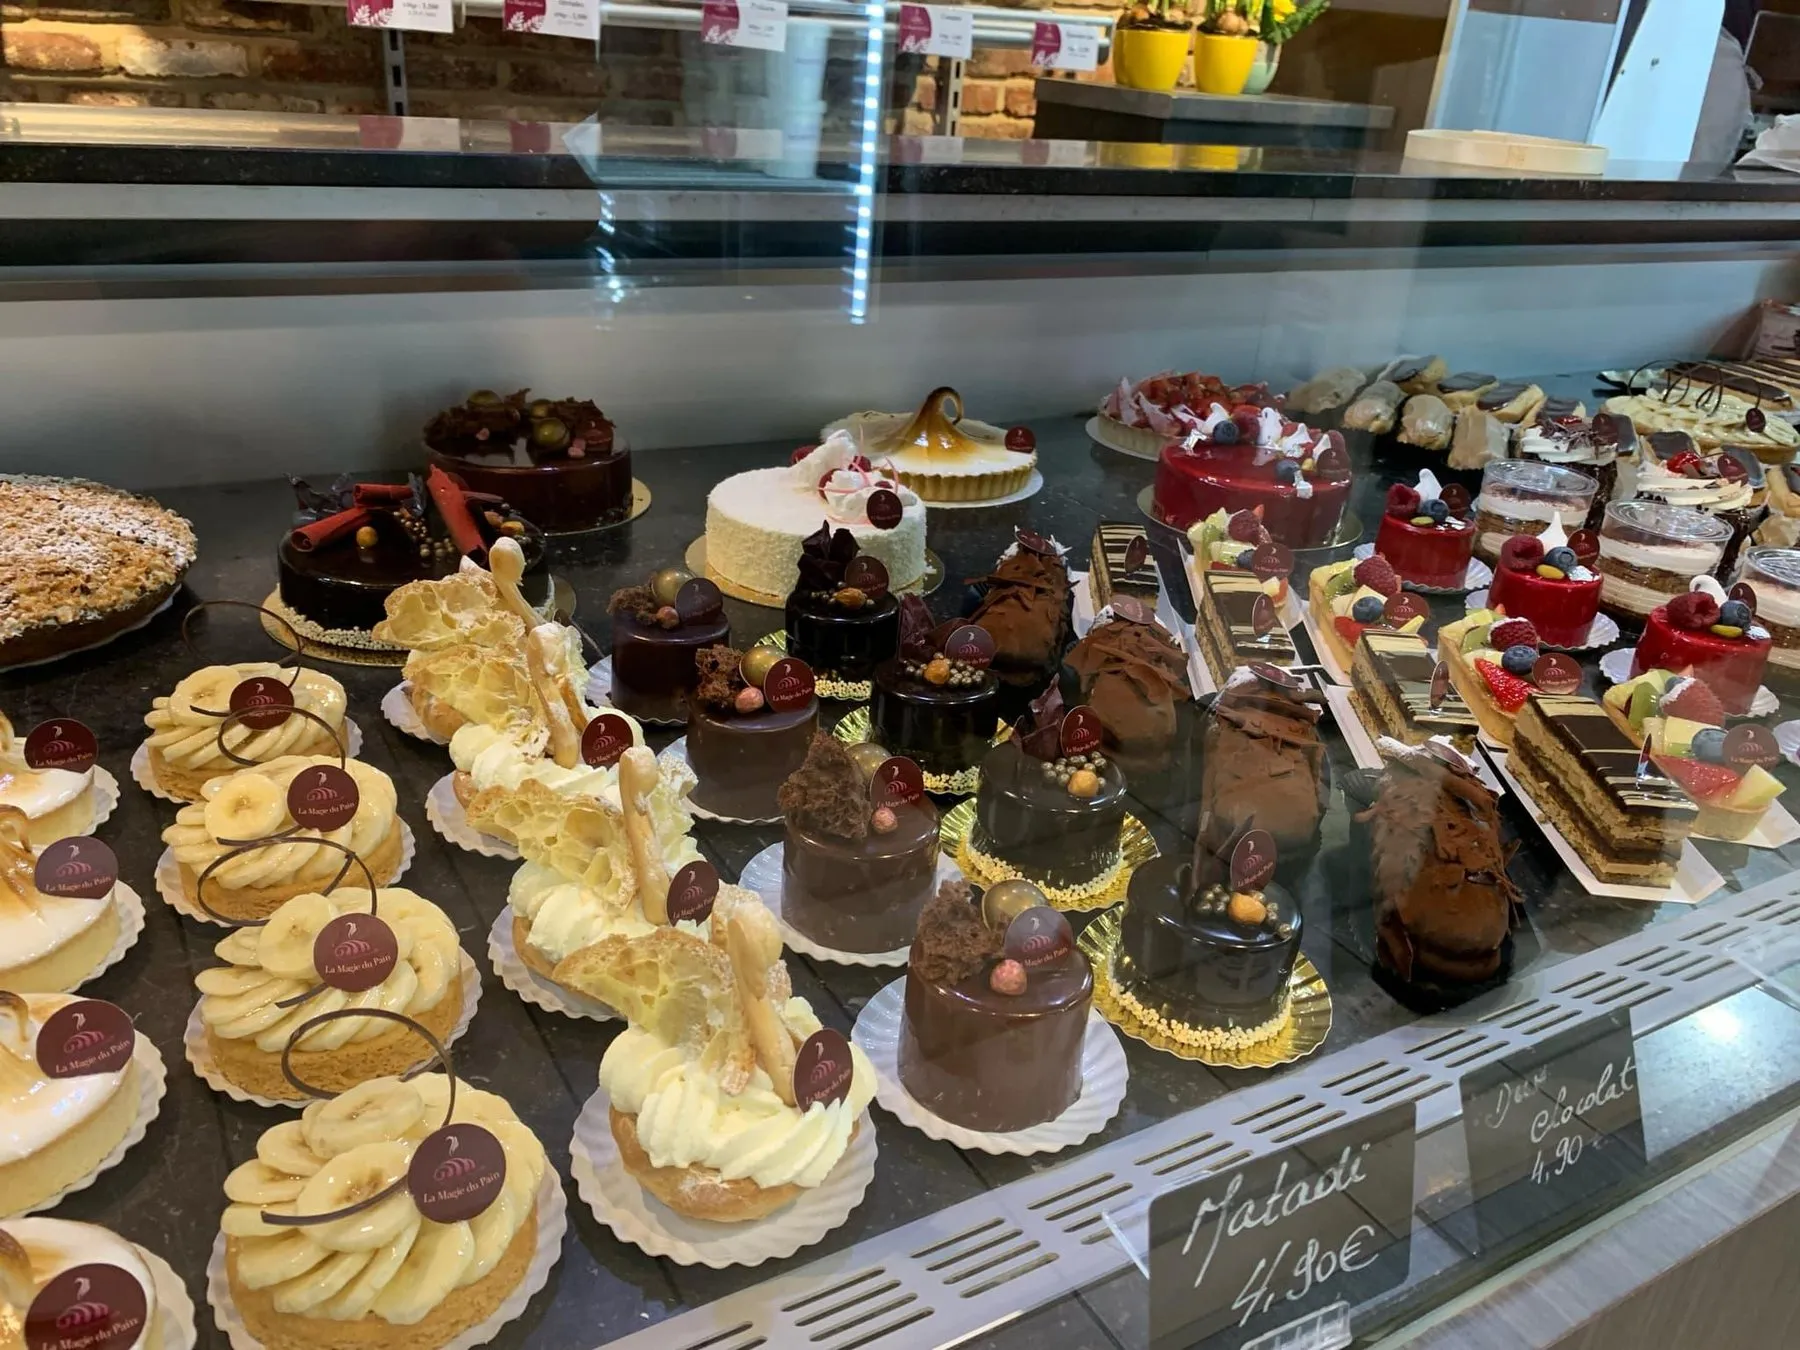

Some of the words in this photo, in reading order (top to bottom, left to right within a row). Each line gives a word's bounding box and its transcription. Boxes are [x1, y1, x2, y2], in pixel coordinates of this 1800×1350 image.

[77, 752, 93, 761] Pain
[298, 807, 308, 815] La
[309, 806, 329, 815] Magie
[330, 803, 340, 812] du
[340, 801, 355, 811] Pain
[46, 883, 57, 892] La
[58, 881, 81, 892] Magie
[82, 879, 93, 889] du
[93, 876, 112, 887] Pain
[325, 965, 336, 974] La
[337, 962, 361, 974] Magie
[361, 958, 374, 969] du
[373, 954, 391, 967] Pain
[55, 1063, 69, 1074] La
[69, 1053, 97, 1071] Magie
[97, 1049, 111, 1062] du
[110, 1039, 131, 1055] Pain
[423, 1192, 436, 1204] La
[438, 1186, 466, 1203] Magie
[466, 1178, 481, 1194] du
[480, 1170, 501, 1188] Pain
[60, 1332, 95, 1350] Magie
[95, 1327, 112, 1343] du
[111, 1317, 139, 1335] Pain
